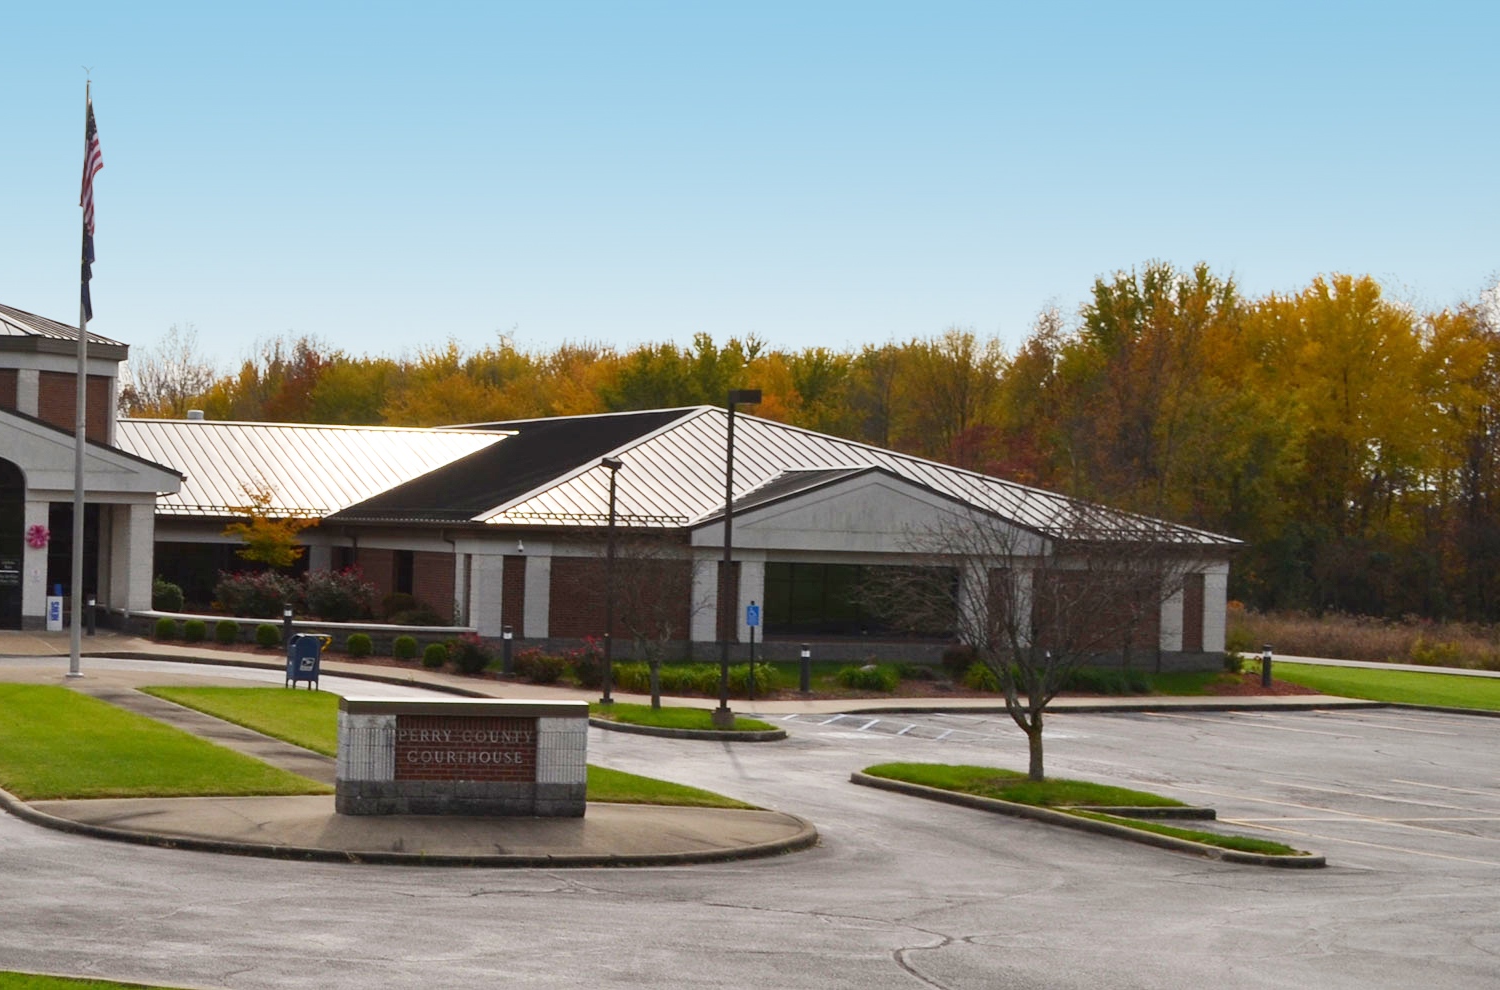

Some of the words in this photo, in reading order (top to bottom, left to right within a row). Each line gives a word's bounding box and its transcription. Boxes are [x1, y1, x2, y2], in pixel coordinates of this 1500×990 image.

[51, 601, 60, 621] NEWS
[398, 729, 452, 742] PERRY
[461, 730, 533, 743] COUNTY
[406, 750, 523, 764] COURTHOUSE
